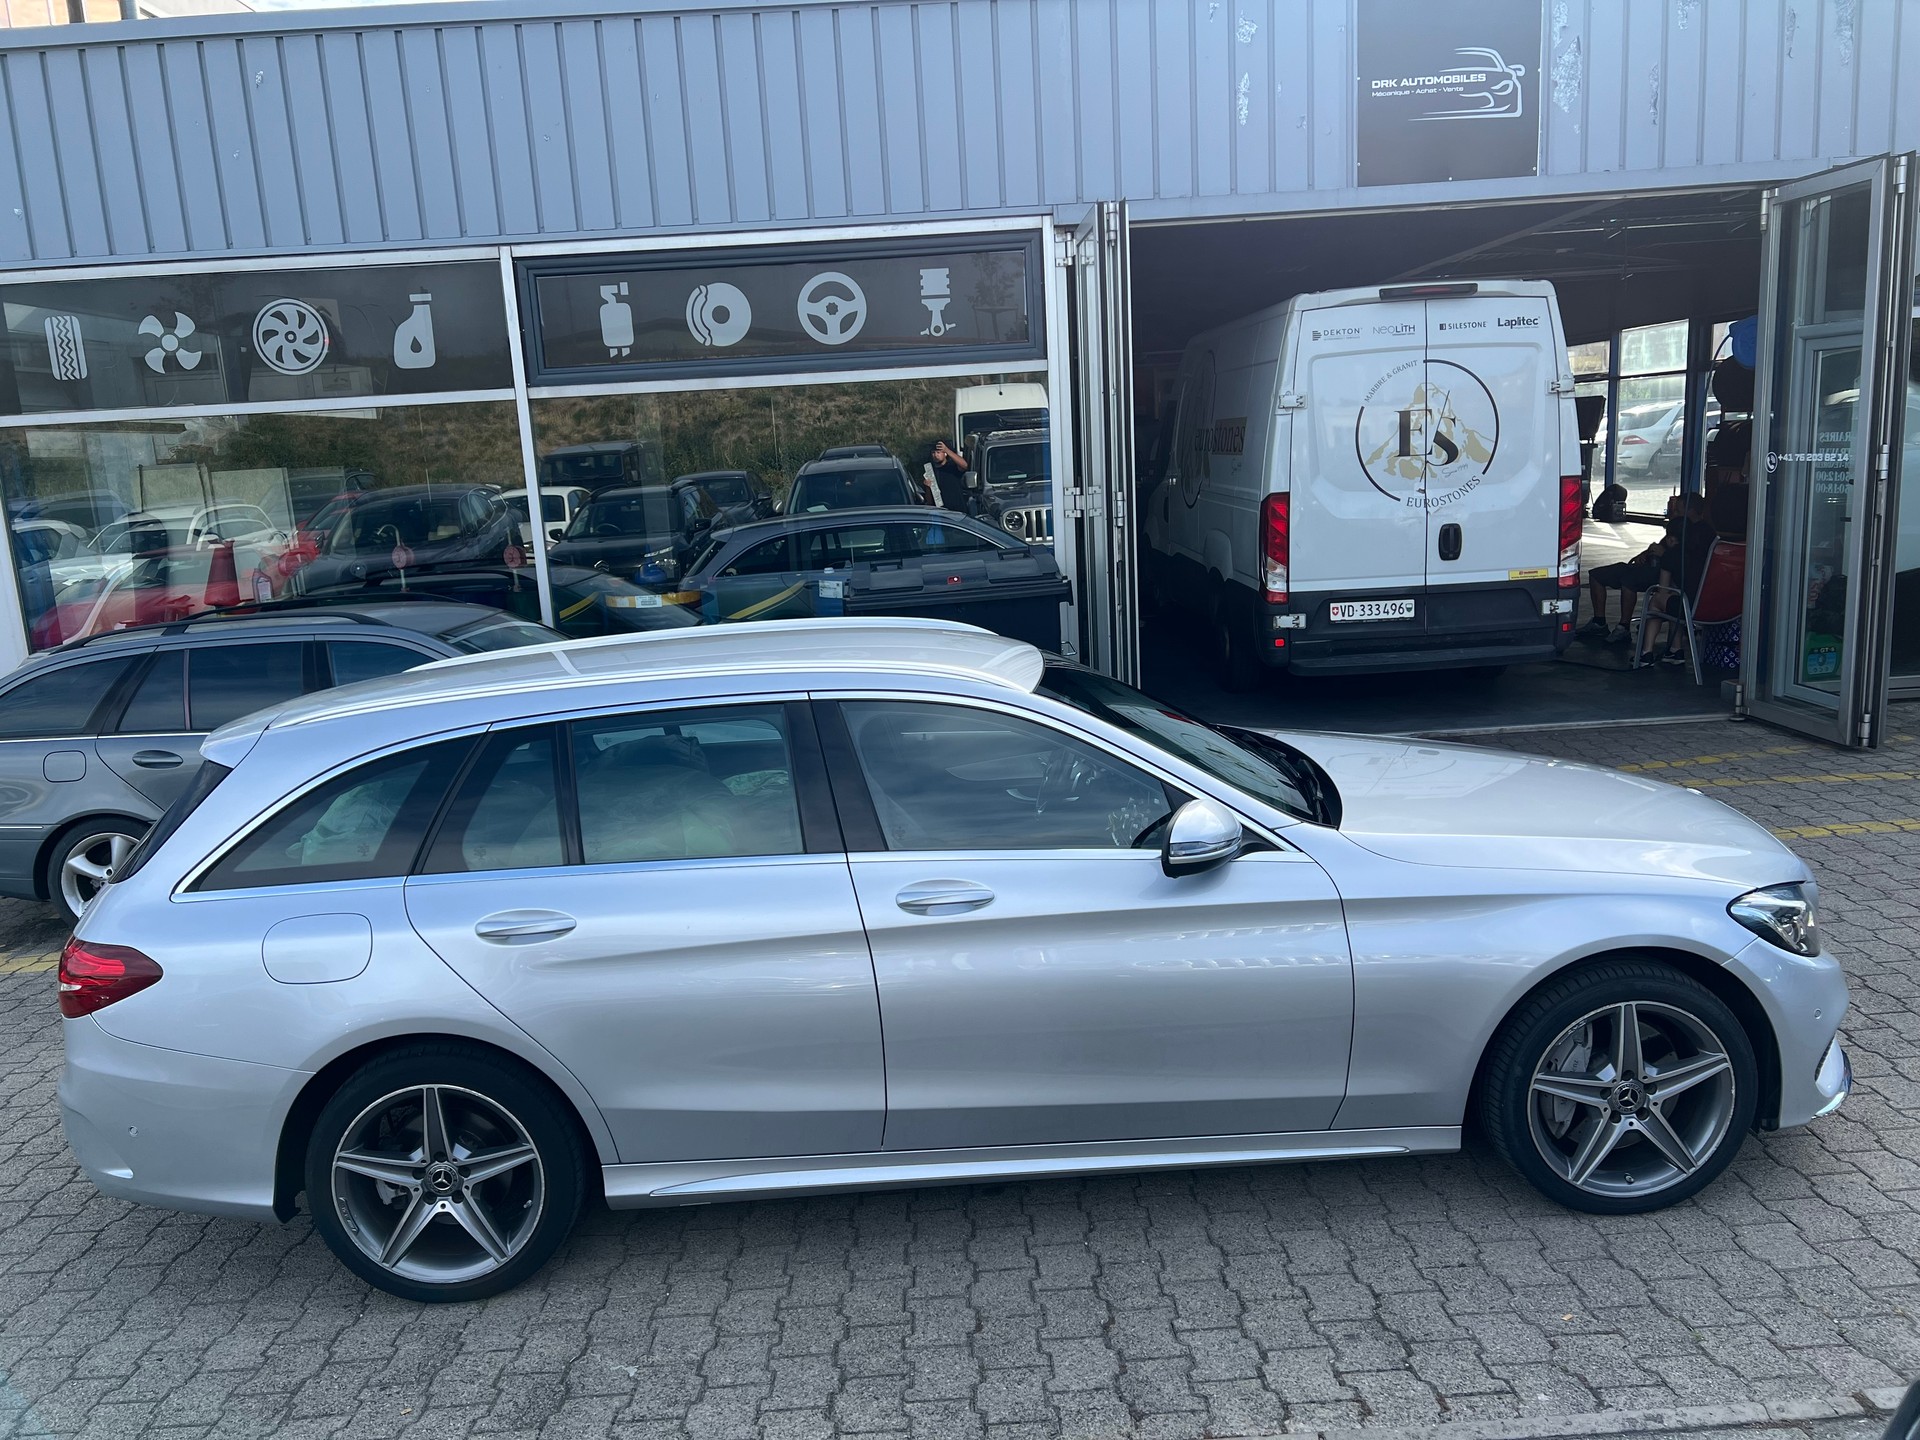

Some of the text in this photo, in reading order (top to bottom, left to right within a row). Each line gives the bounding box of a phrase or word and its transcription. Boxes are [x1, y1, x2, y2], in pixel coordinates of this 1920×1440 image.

[1371, 73, 1487, 89] DRK AUTOMOBILES
[1415, 87, 1438, 95] Achat
[1448, 321, 1487, 330] SILESTONE
[1497, 316, 1539, 330] Lapitec
[1323, 327, 1361, 337] DEKTON
[1364, 376, 1388, 403] MARBRE
[1392, 360, 1418, 375] GRANIT
[1778, 453, 1794, 462] +41
[1806, 453, 1824, 462] 203
[1837, 453, 1849, 462] 14
[1406, 475, 1481, 509] EUROSTONES
